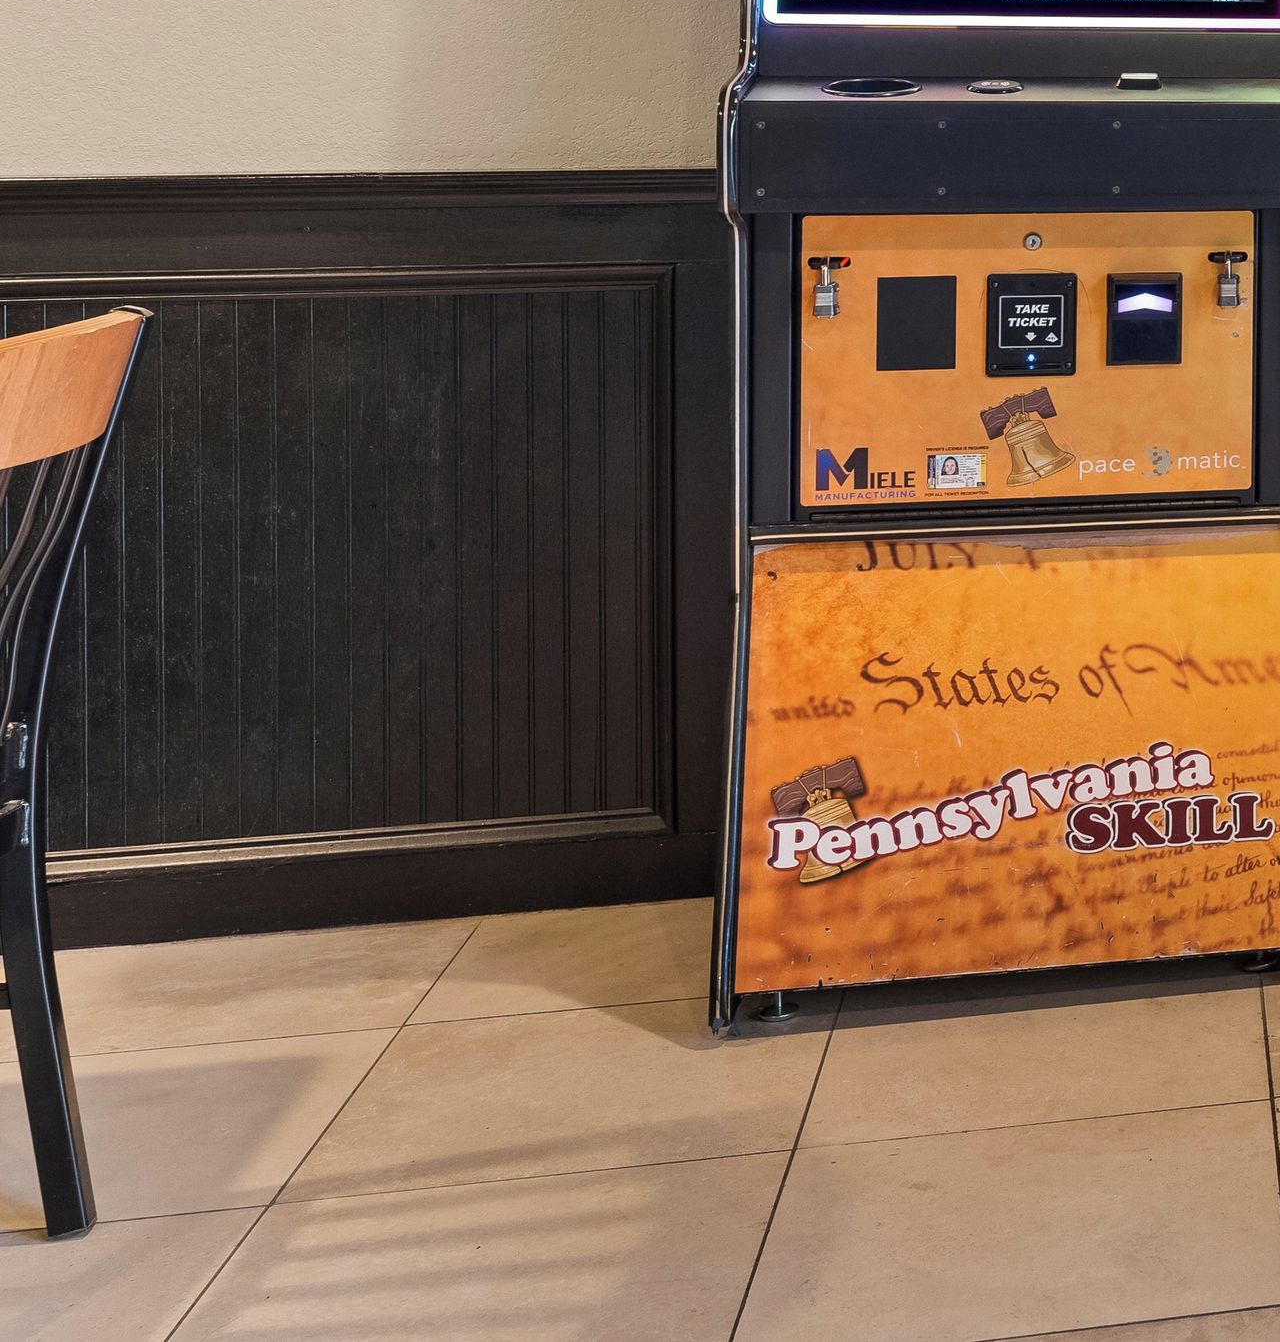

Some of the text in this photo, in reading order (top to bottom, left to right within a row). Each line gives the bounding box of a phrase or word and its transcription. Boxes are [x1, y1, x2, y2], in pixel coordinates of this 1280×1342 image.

[1007, 317, 1057, 327] TICKET
[1014, 304, 1050, 314] TAKE
[815, 447, 916, 492] MIELE
[1078, 449, 1241, 481] pace matic
[815, 490, 916, 502] MANUFACTURING
[860, 651, 1060, 715] States
[1076, 642, 1134, 717] of
[767, 741, 1215, 871] Pennsylvania
[1065, 791, 1277, 855] SKILL
